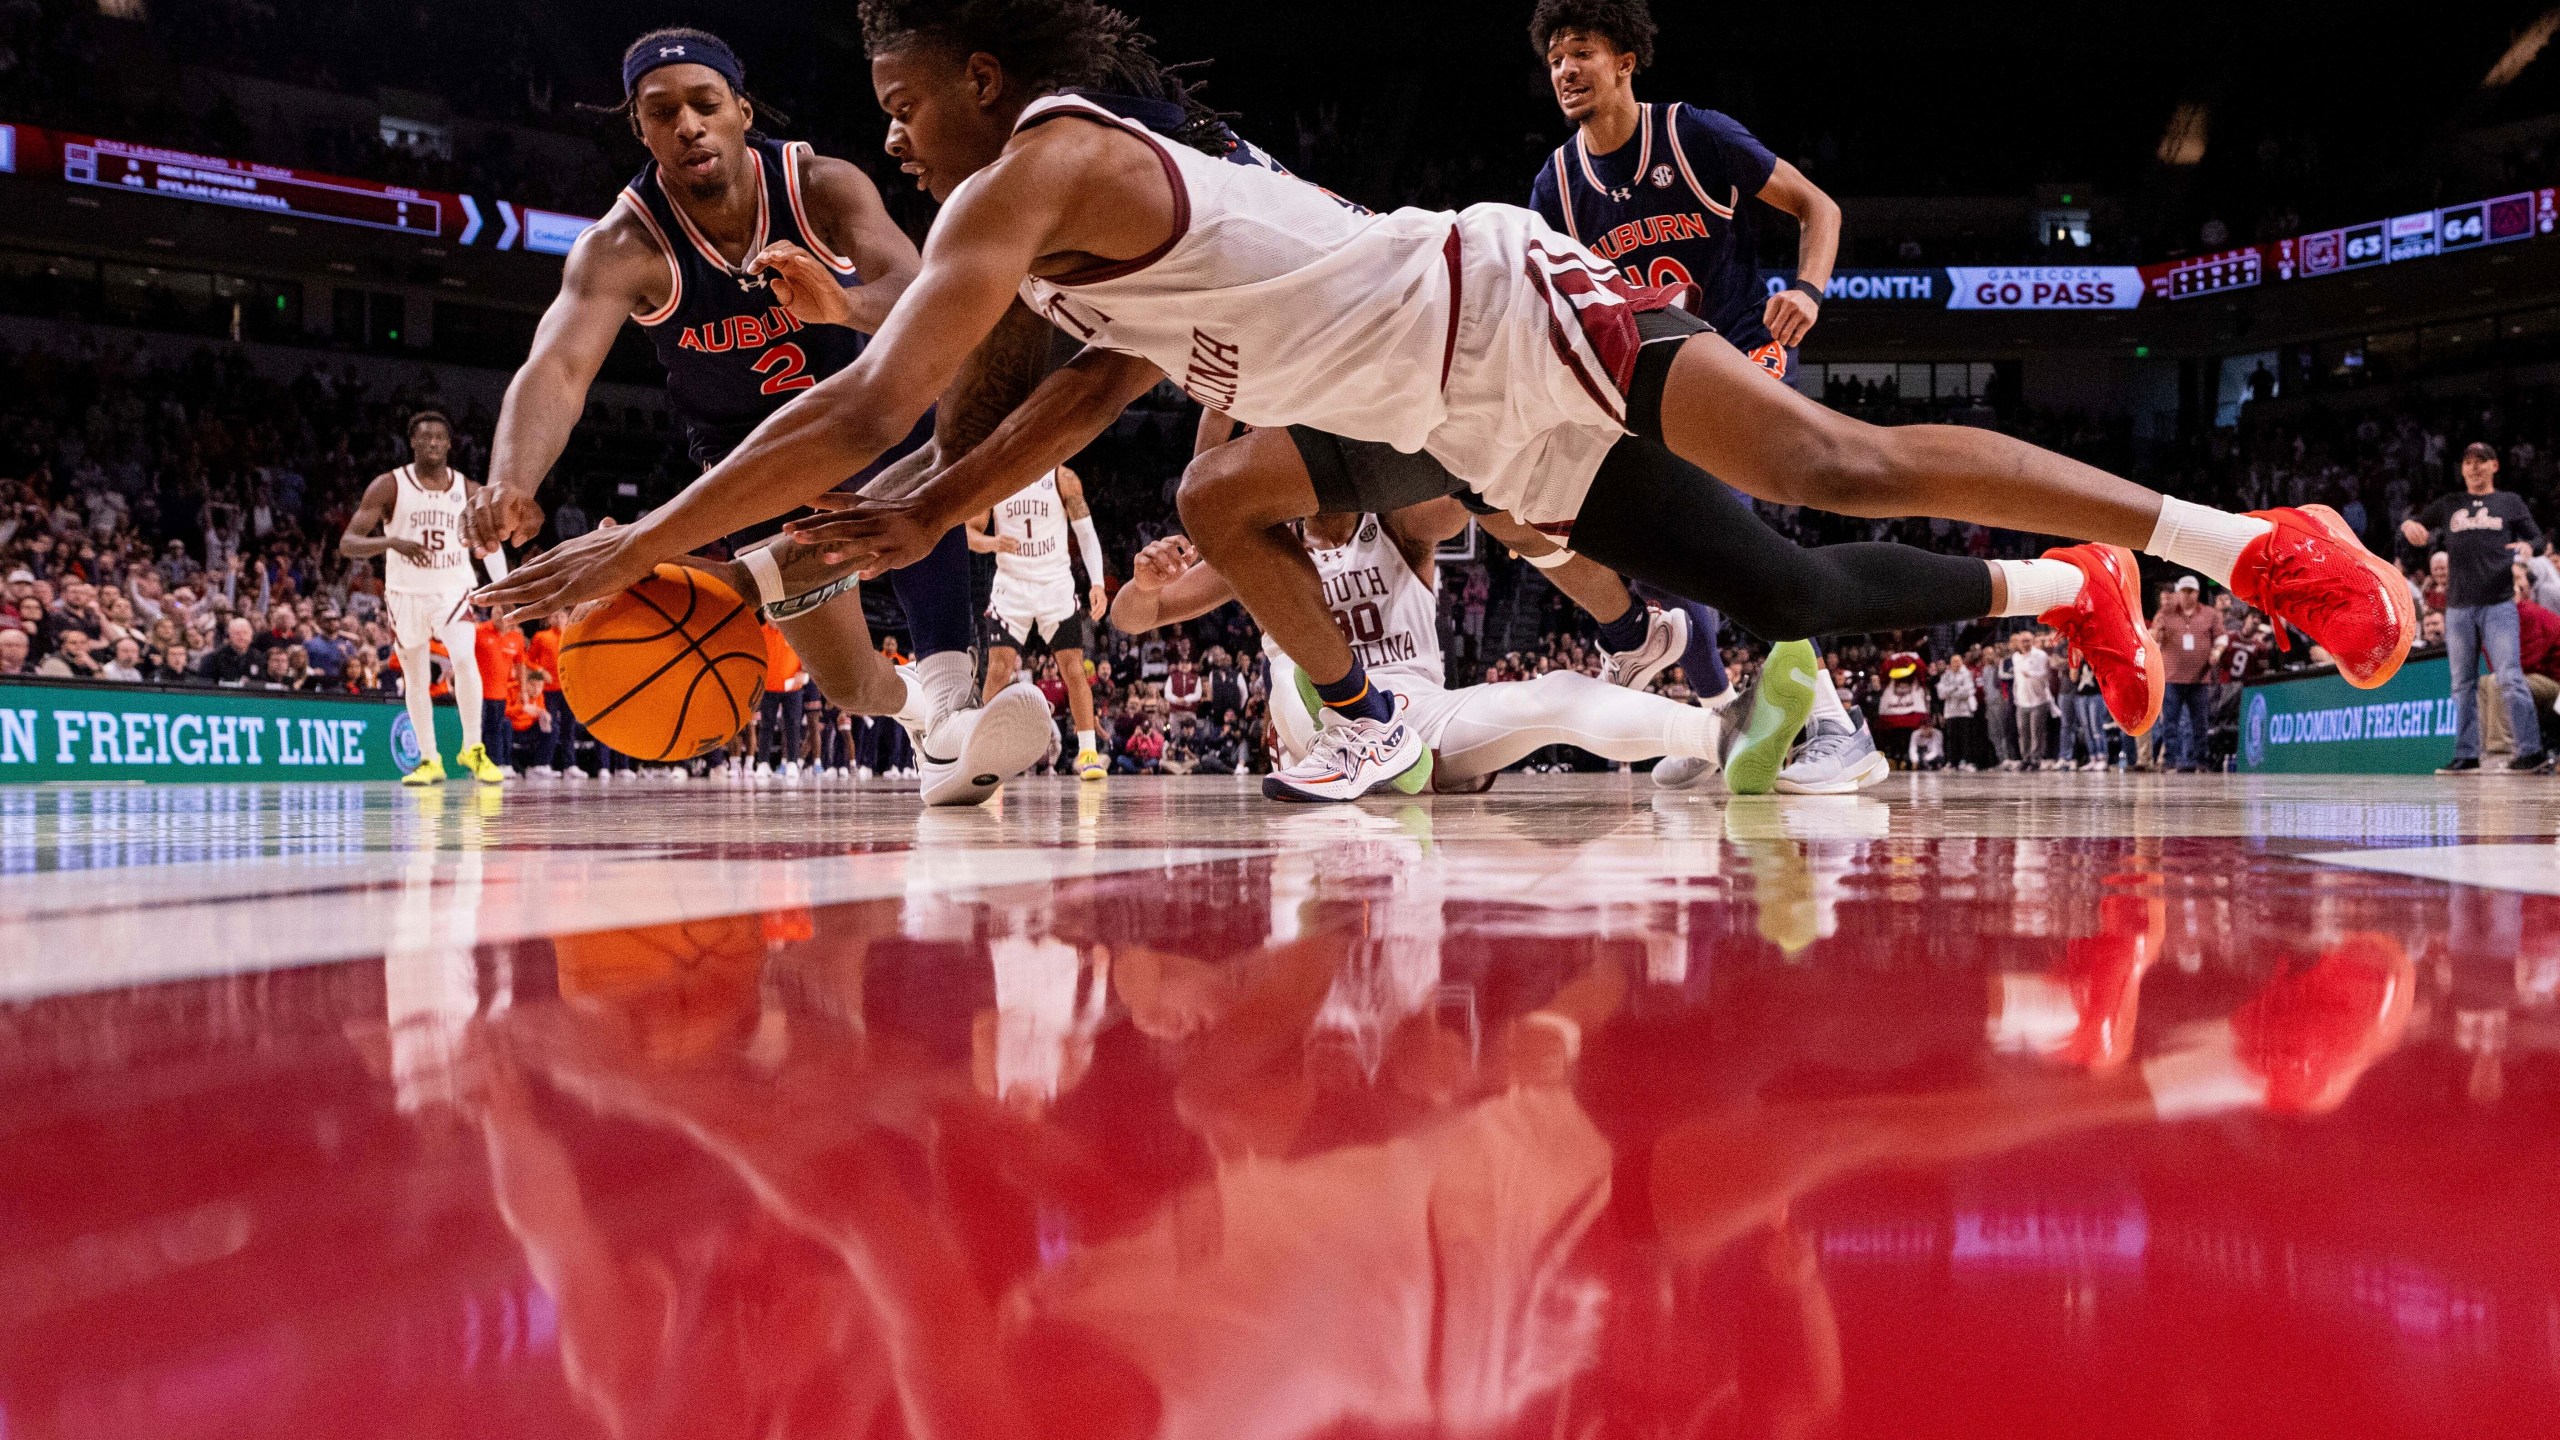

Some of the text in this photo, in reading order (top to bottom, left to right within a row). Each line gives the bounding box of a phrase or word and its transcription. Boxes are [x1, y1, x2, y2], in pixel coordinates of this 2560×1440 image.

[2444, 214, 2483, 241] 64
[2347, 234, 2381, 259] 63
[1824, 275, 1932, 300] MONTH
[1987, 268, 2102, 282] GAMECOCK
[1975, 282, 2116, 305] GO PASS
[677, 306, 805, 353] AUBU
[750, 341, 817, 396] 2
[1183, 326, 1239, 411] OLINA
[410, 510, 455, 530] SOUTH
[1006, 499, 1049, 518] SOUTH
[421, 529, 446, 551] 15
[1023, 518, 1033, 539] 1
[1016, 536, 1056, 557] ROLINA
[1322, 566, 1389, 608] OUTH
[1350, 630, 1418, 668] LINA
[2230, 649, 2249, 678] 9
[2269, 698, 2457, 744] OLD DOMINION FREIGHT LI
[53, 710, 264, 765] FREIGHT
[277, 717, 366, 766] LINE
